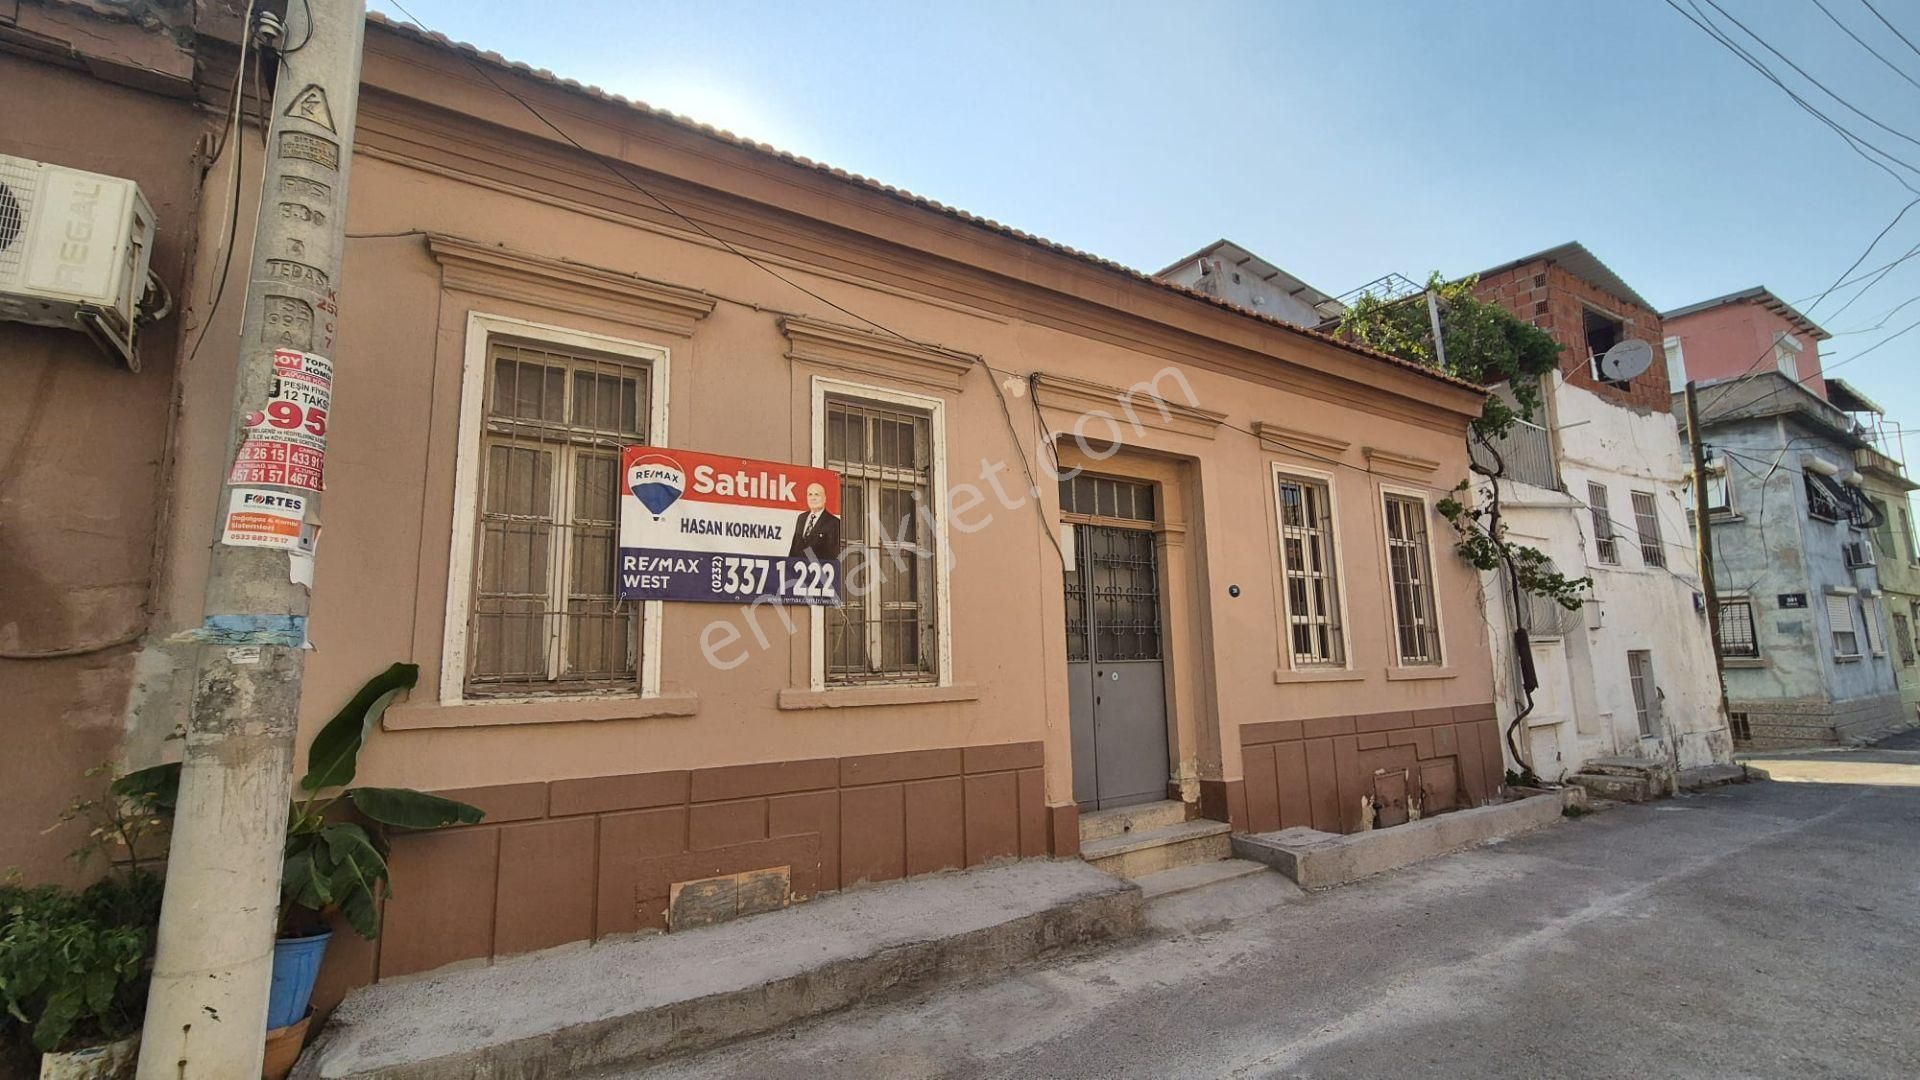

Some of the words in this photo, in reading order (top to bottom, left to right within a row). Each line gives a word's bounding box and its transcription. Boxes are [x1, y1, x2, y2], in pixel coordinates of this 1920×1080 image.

[284, 390, 299, 402] 12
[253, 448, 267, 460] 26
[271, 449, 285, 462] 15
[291, 452, 310, 466] 433
[252, 469, 264, 482] 51
[269, 470, 283, 483] 57
[290, 473, 308, 486] 467
[635, 468, 680, 484] RE/MAX
[692, 464, 798, 503] Satılık
[244, 493, 302, 510] FORTES
[680, 518, 723, 536] HASAN
[725, 522, 782, 541] KORKMAZ
[623, 556, 700, 574] RE/MAX
[622, 575, 671, 589] WEST
[711, 556, 724, 593] (0232)
[724, 557, 770, 595] 337
